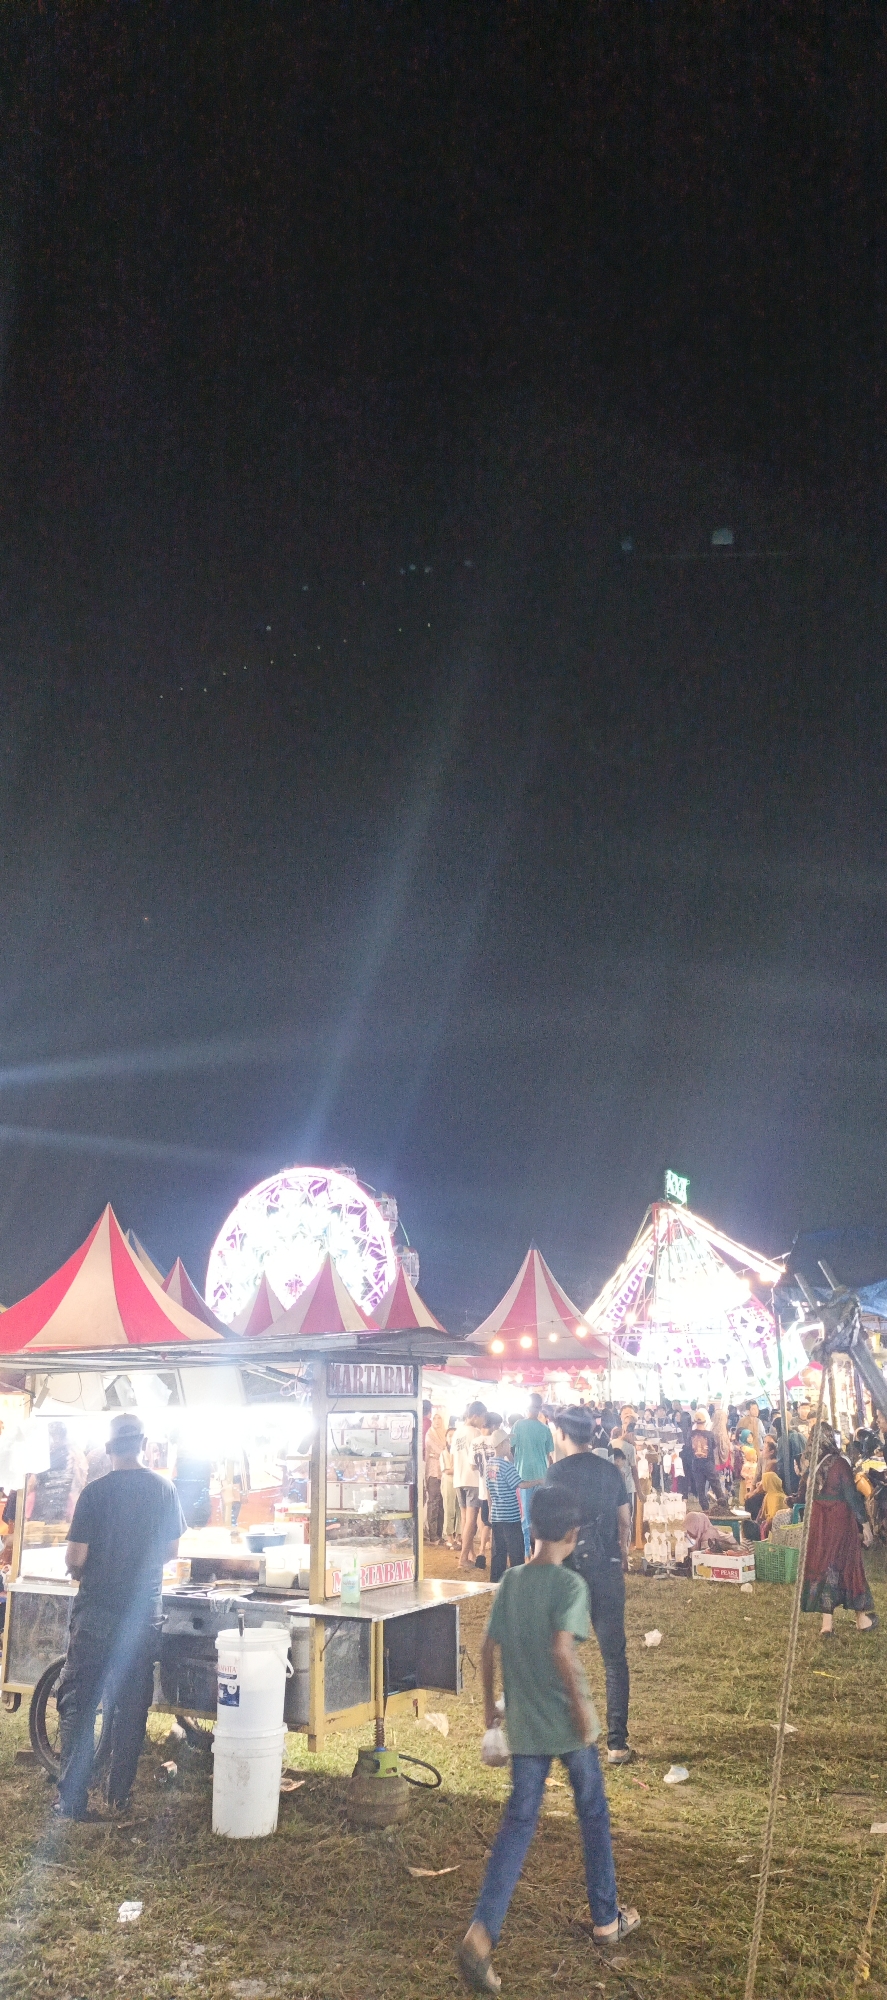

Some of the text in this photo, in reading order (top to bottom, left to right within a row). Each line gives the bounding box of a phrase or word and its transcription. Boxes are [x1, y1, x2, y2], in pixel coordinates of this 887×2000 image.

[329, 1364, 413, 1393] MARTABAK
[333, 1559, 413, 1593] MRTABAK
[721, 1569, 738, 1578] PEARS
